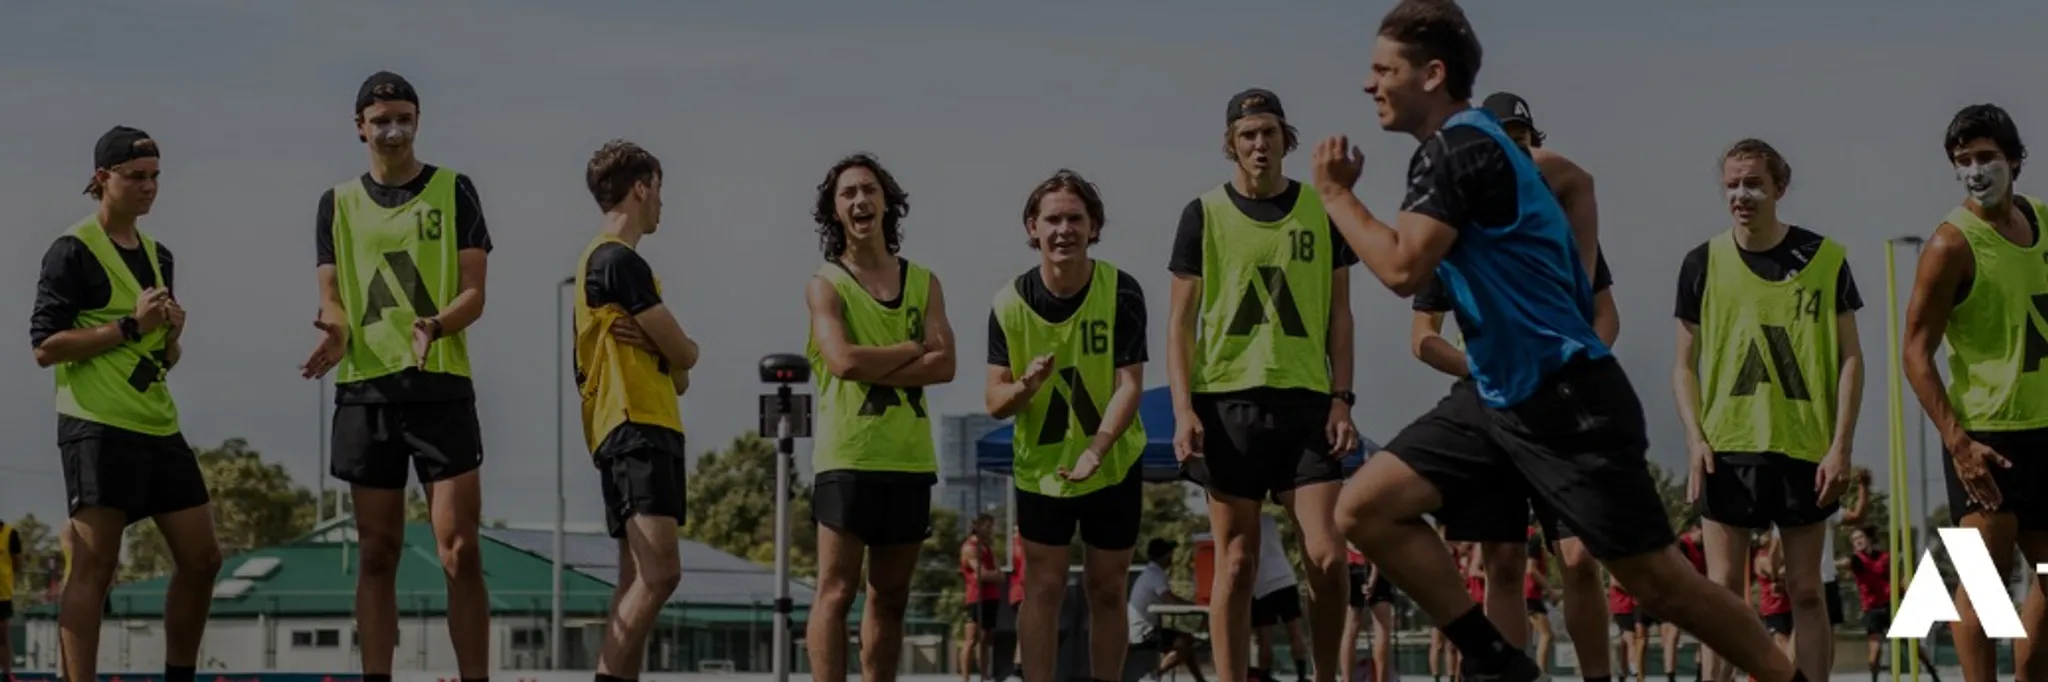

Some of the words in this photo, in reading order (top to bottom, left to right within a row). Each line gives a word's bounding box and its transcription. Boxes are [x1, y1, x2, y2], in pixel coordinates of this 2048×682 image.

[1289, 230, 1315, 262] 18
[1226, 266, 1309, 338] A
[1795, 287, 1821, 323] 14
[1080, 320, 1108, 354] 16
[1729, 324, 1811, 401] A
